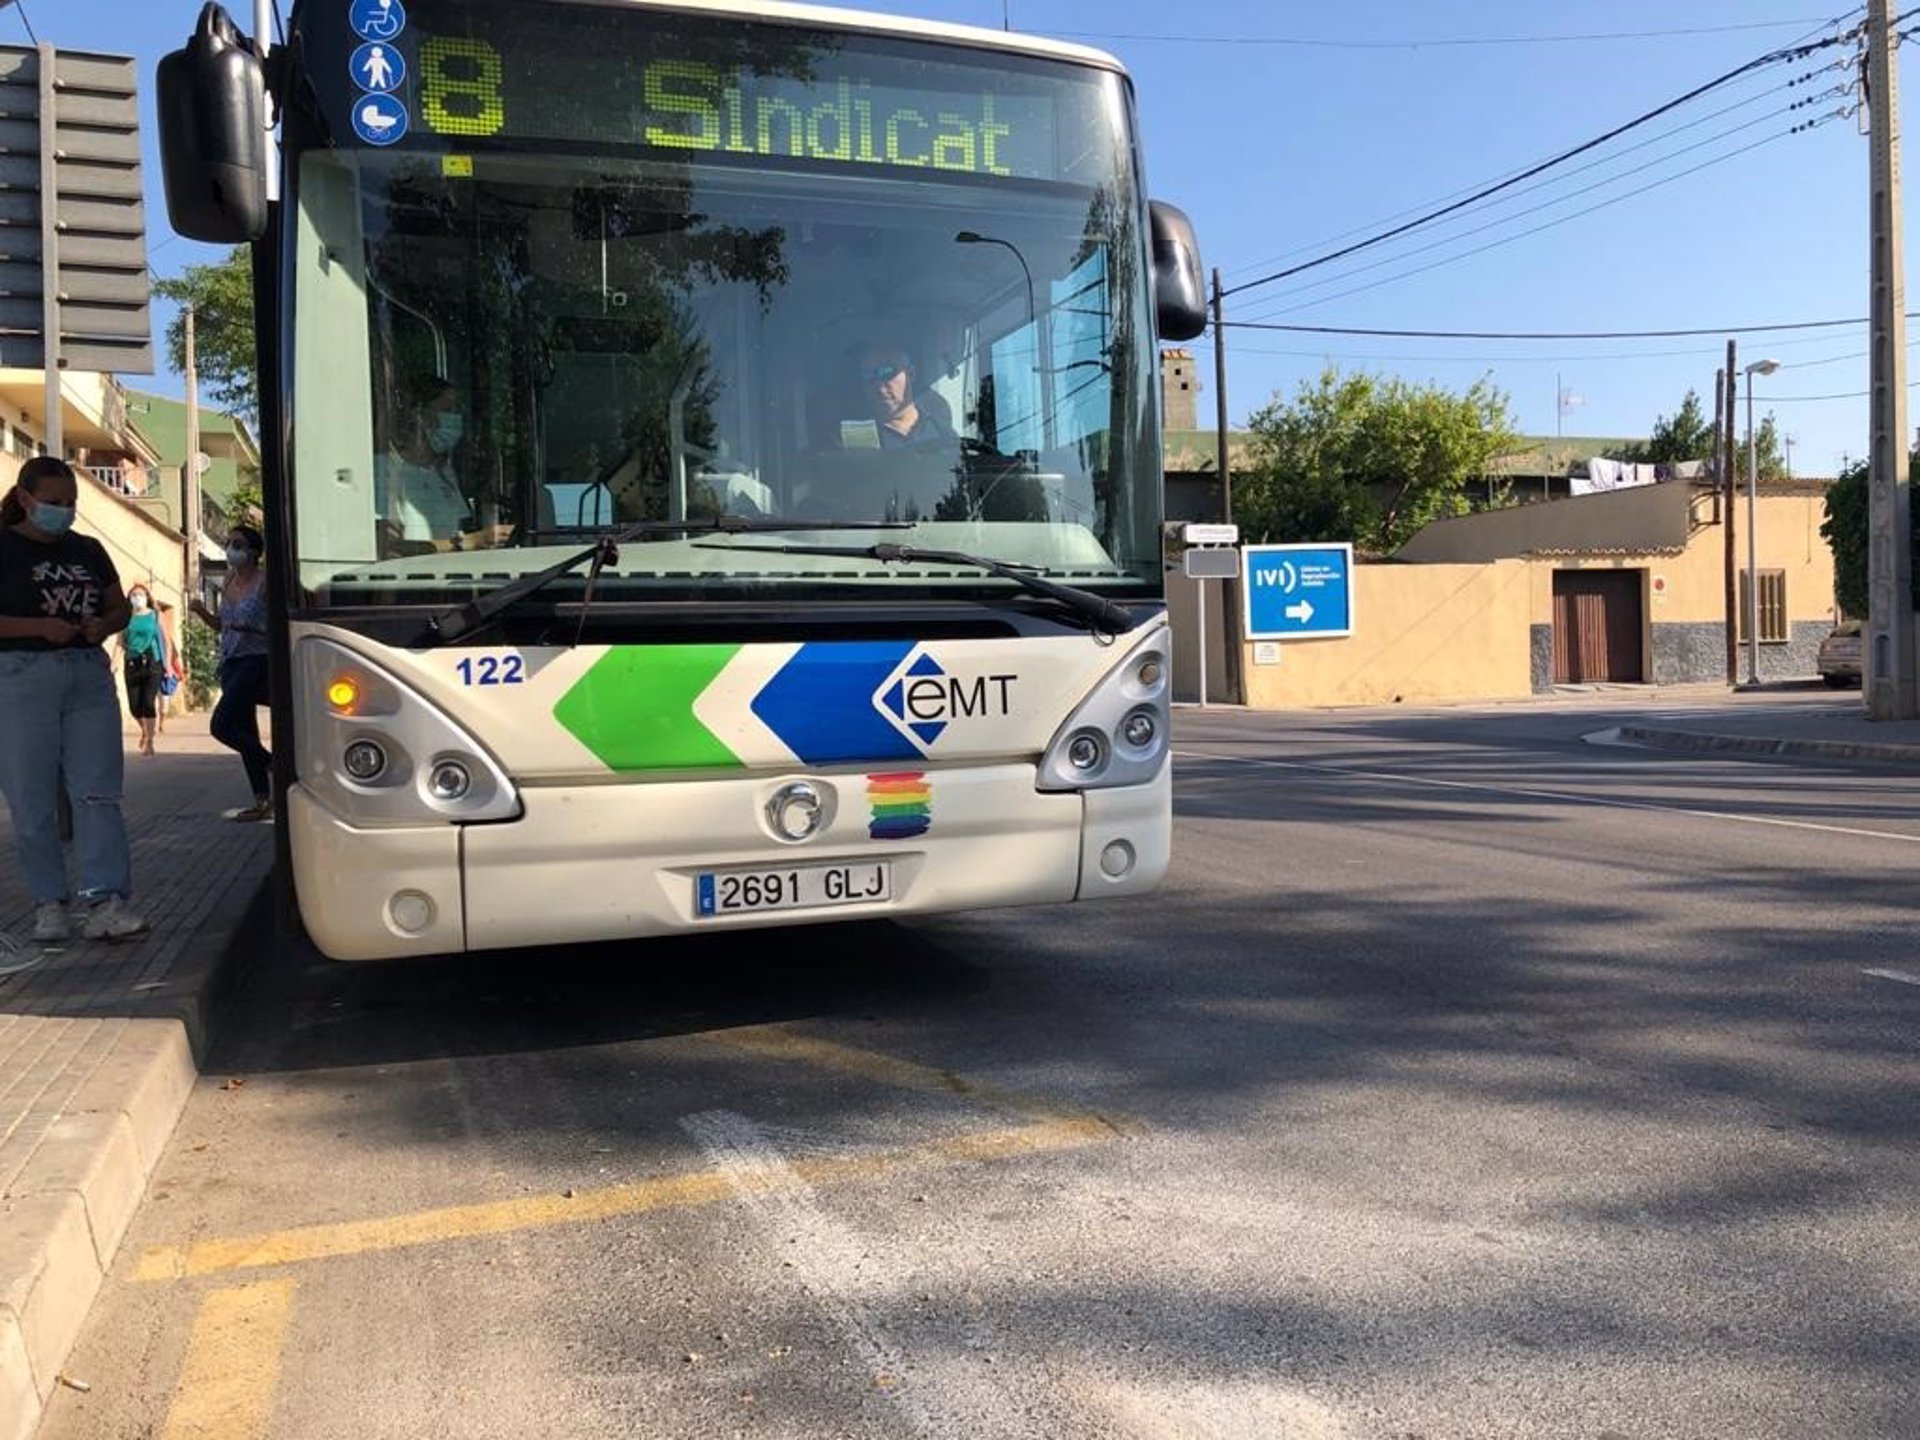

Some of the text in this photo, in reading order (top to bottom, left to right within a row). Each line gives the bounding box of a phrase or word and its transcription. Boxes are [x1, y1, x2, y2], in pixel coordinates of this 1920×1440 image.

[419, 36, 1010, 176] 8 Sindicat
[456, 655, 523, 685] 122
[721, 865, 884, 908] 2691 GLJ
